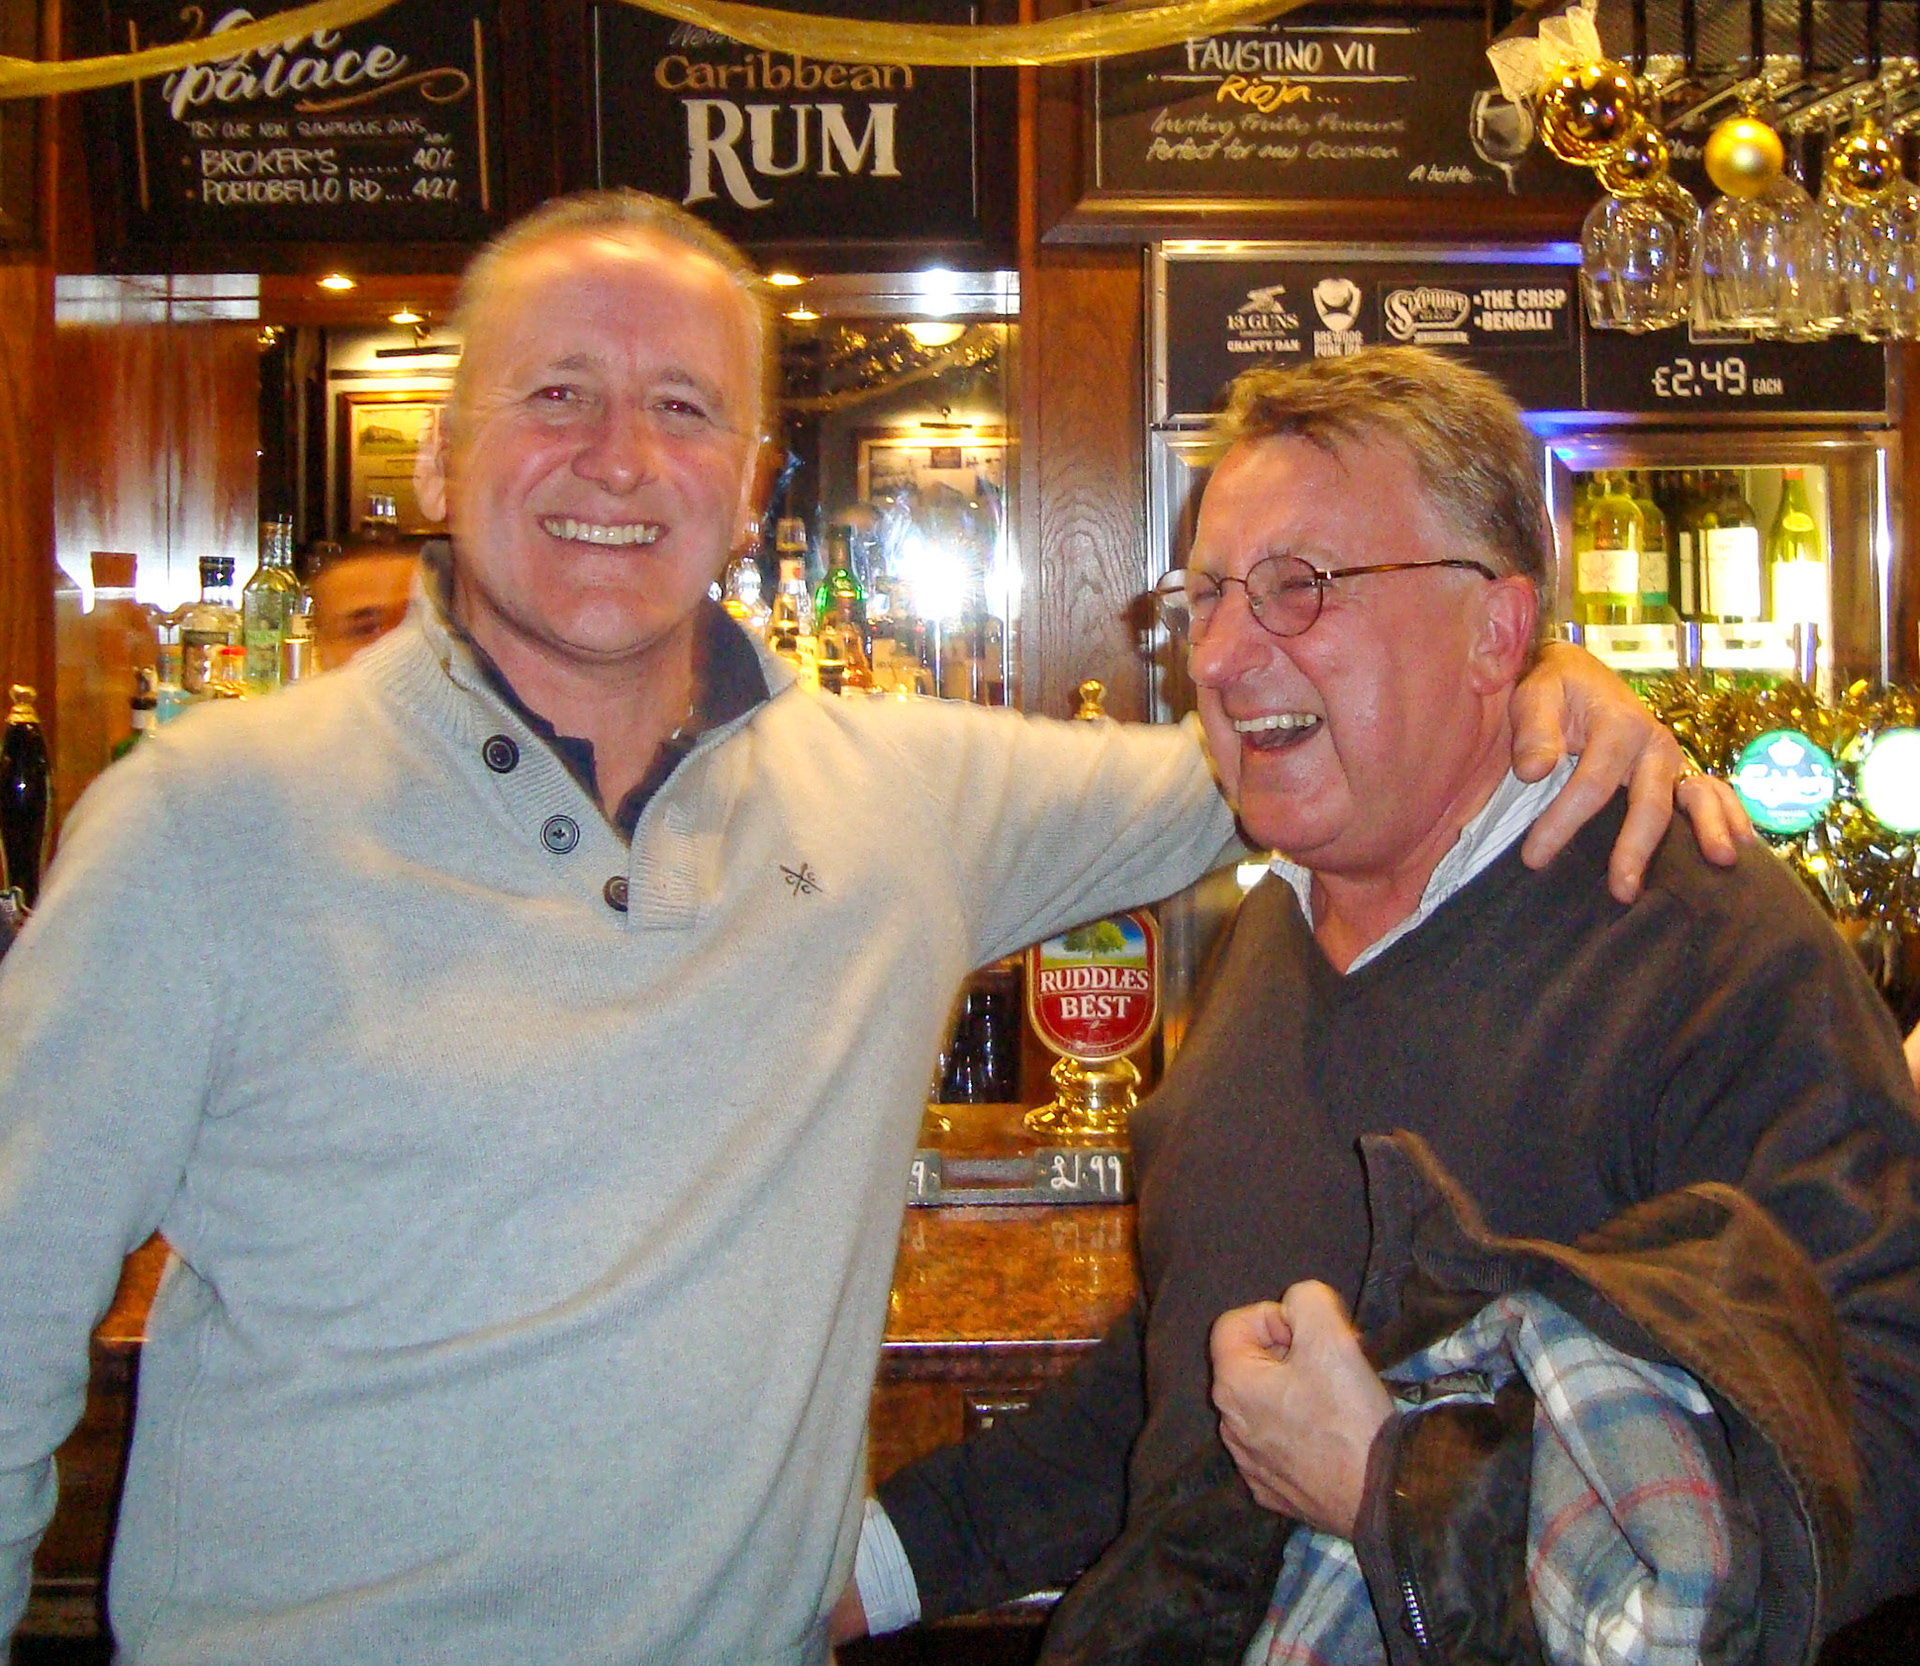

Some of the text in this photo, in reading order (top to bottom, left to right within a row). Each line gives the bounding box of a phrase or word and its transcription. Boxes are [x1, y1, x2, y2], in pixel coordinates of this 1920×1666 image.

[1185, 37, 1377, 72] FAUSTINO VII
[162, 44, 408, 122] palace
[655, 52, 916, 91] Caribbean
[681, 99, 902, 210] RUM
[202, 178, 341, 204] PORTOBELLO
[1481, 288, 1568, 309] THE CRISP
[1248, 312, 1300, 330] GUNS
[1482, 310, 1553, 331] BENGALI
[1314, 343, 1343, 358] PUNK
[1651, 357, 1784, 397] £2.49 EACH
[1040, 967, 1150, 992] RUDDLES
[1060, 994, 1131, 1019] BEST
